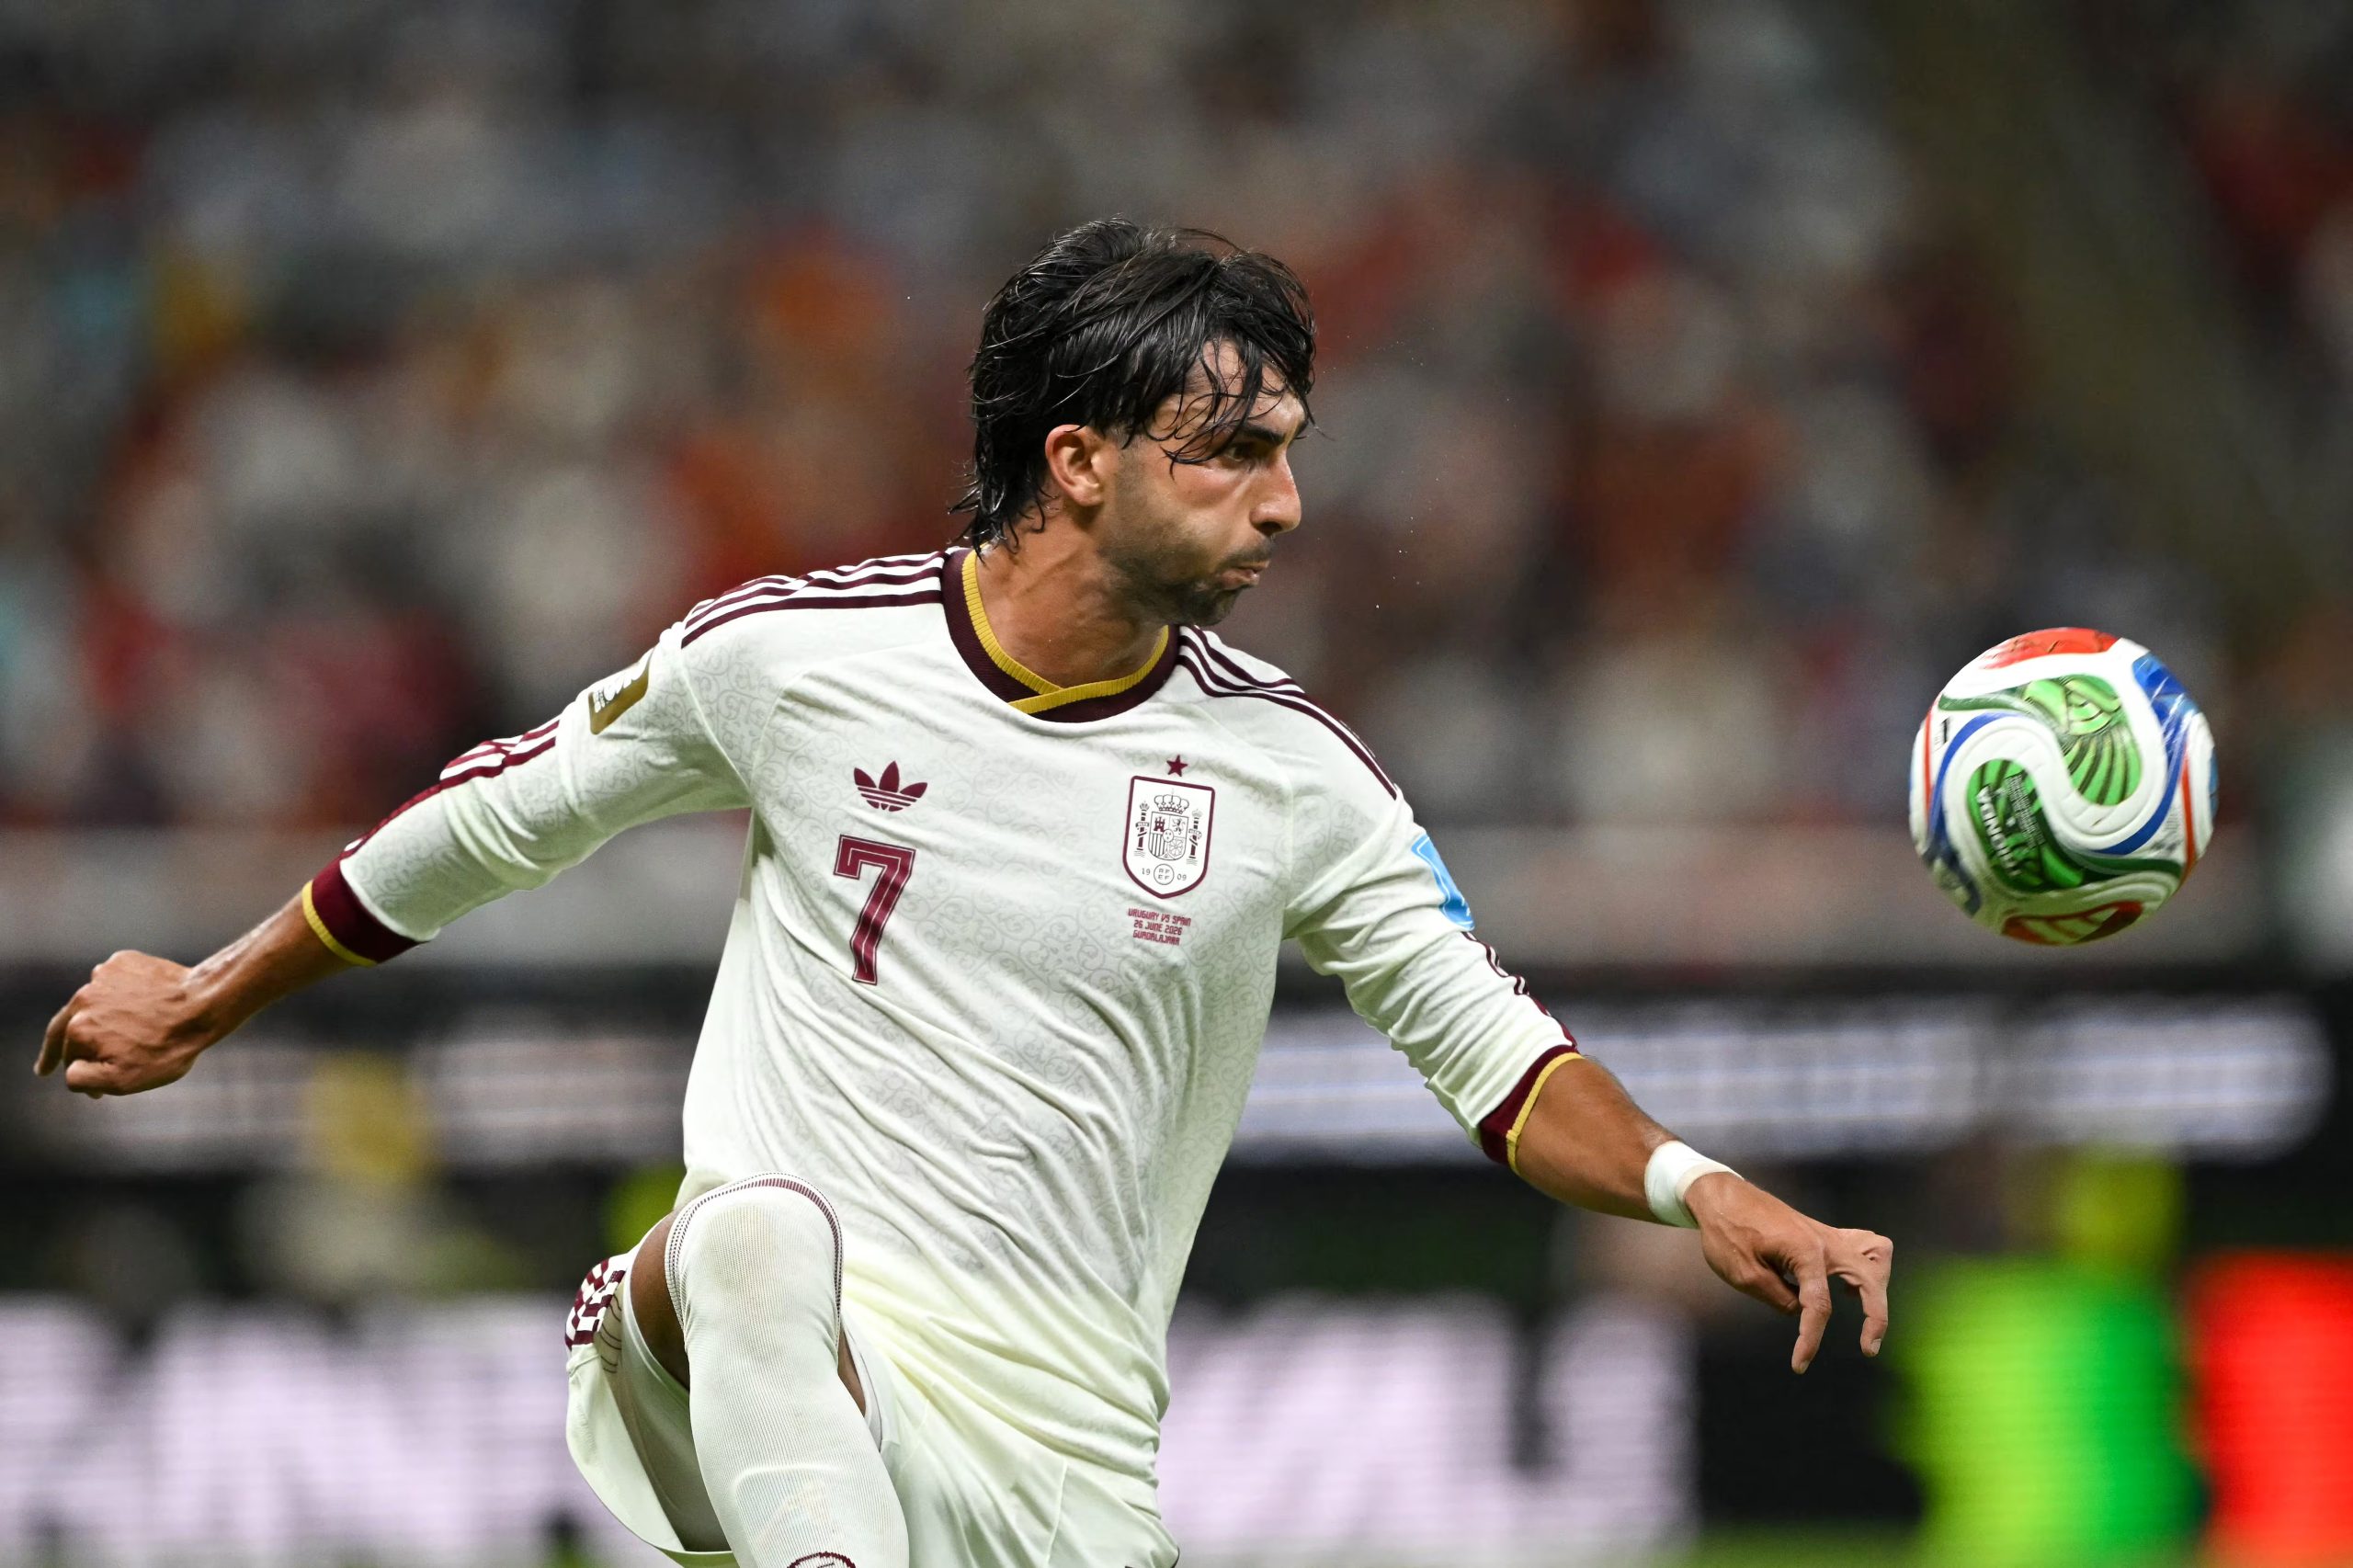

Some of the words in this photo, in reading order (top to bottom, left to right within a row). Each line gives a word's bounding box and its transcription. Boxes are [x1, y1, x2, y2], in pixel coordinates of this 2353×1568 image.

[1142, 868, 1151, 876] 19
[1176, 873, 1187, 881] 09
[833, 834, 916, 986] 7
[1128, 908, 1159, 921] URUGUAY
[1161, 914, 1171, 924] VS
[1172, 915, 1191, 926] SPAIN
[1133, 919, 1143, 929] 26
[1145, 921, 1163, 933] JUNE
[1165, 925, 1183, 936] 2026
[1132, 929, 1180, 946] GUADALAJARA
